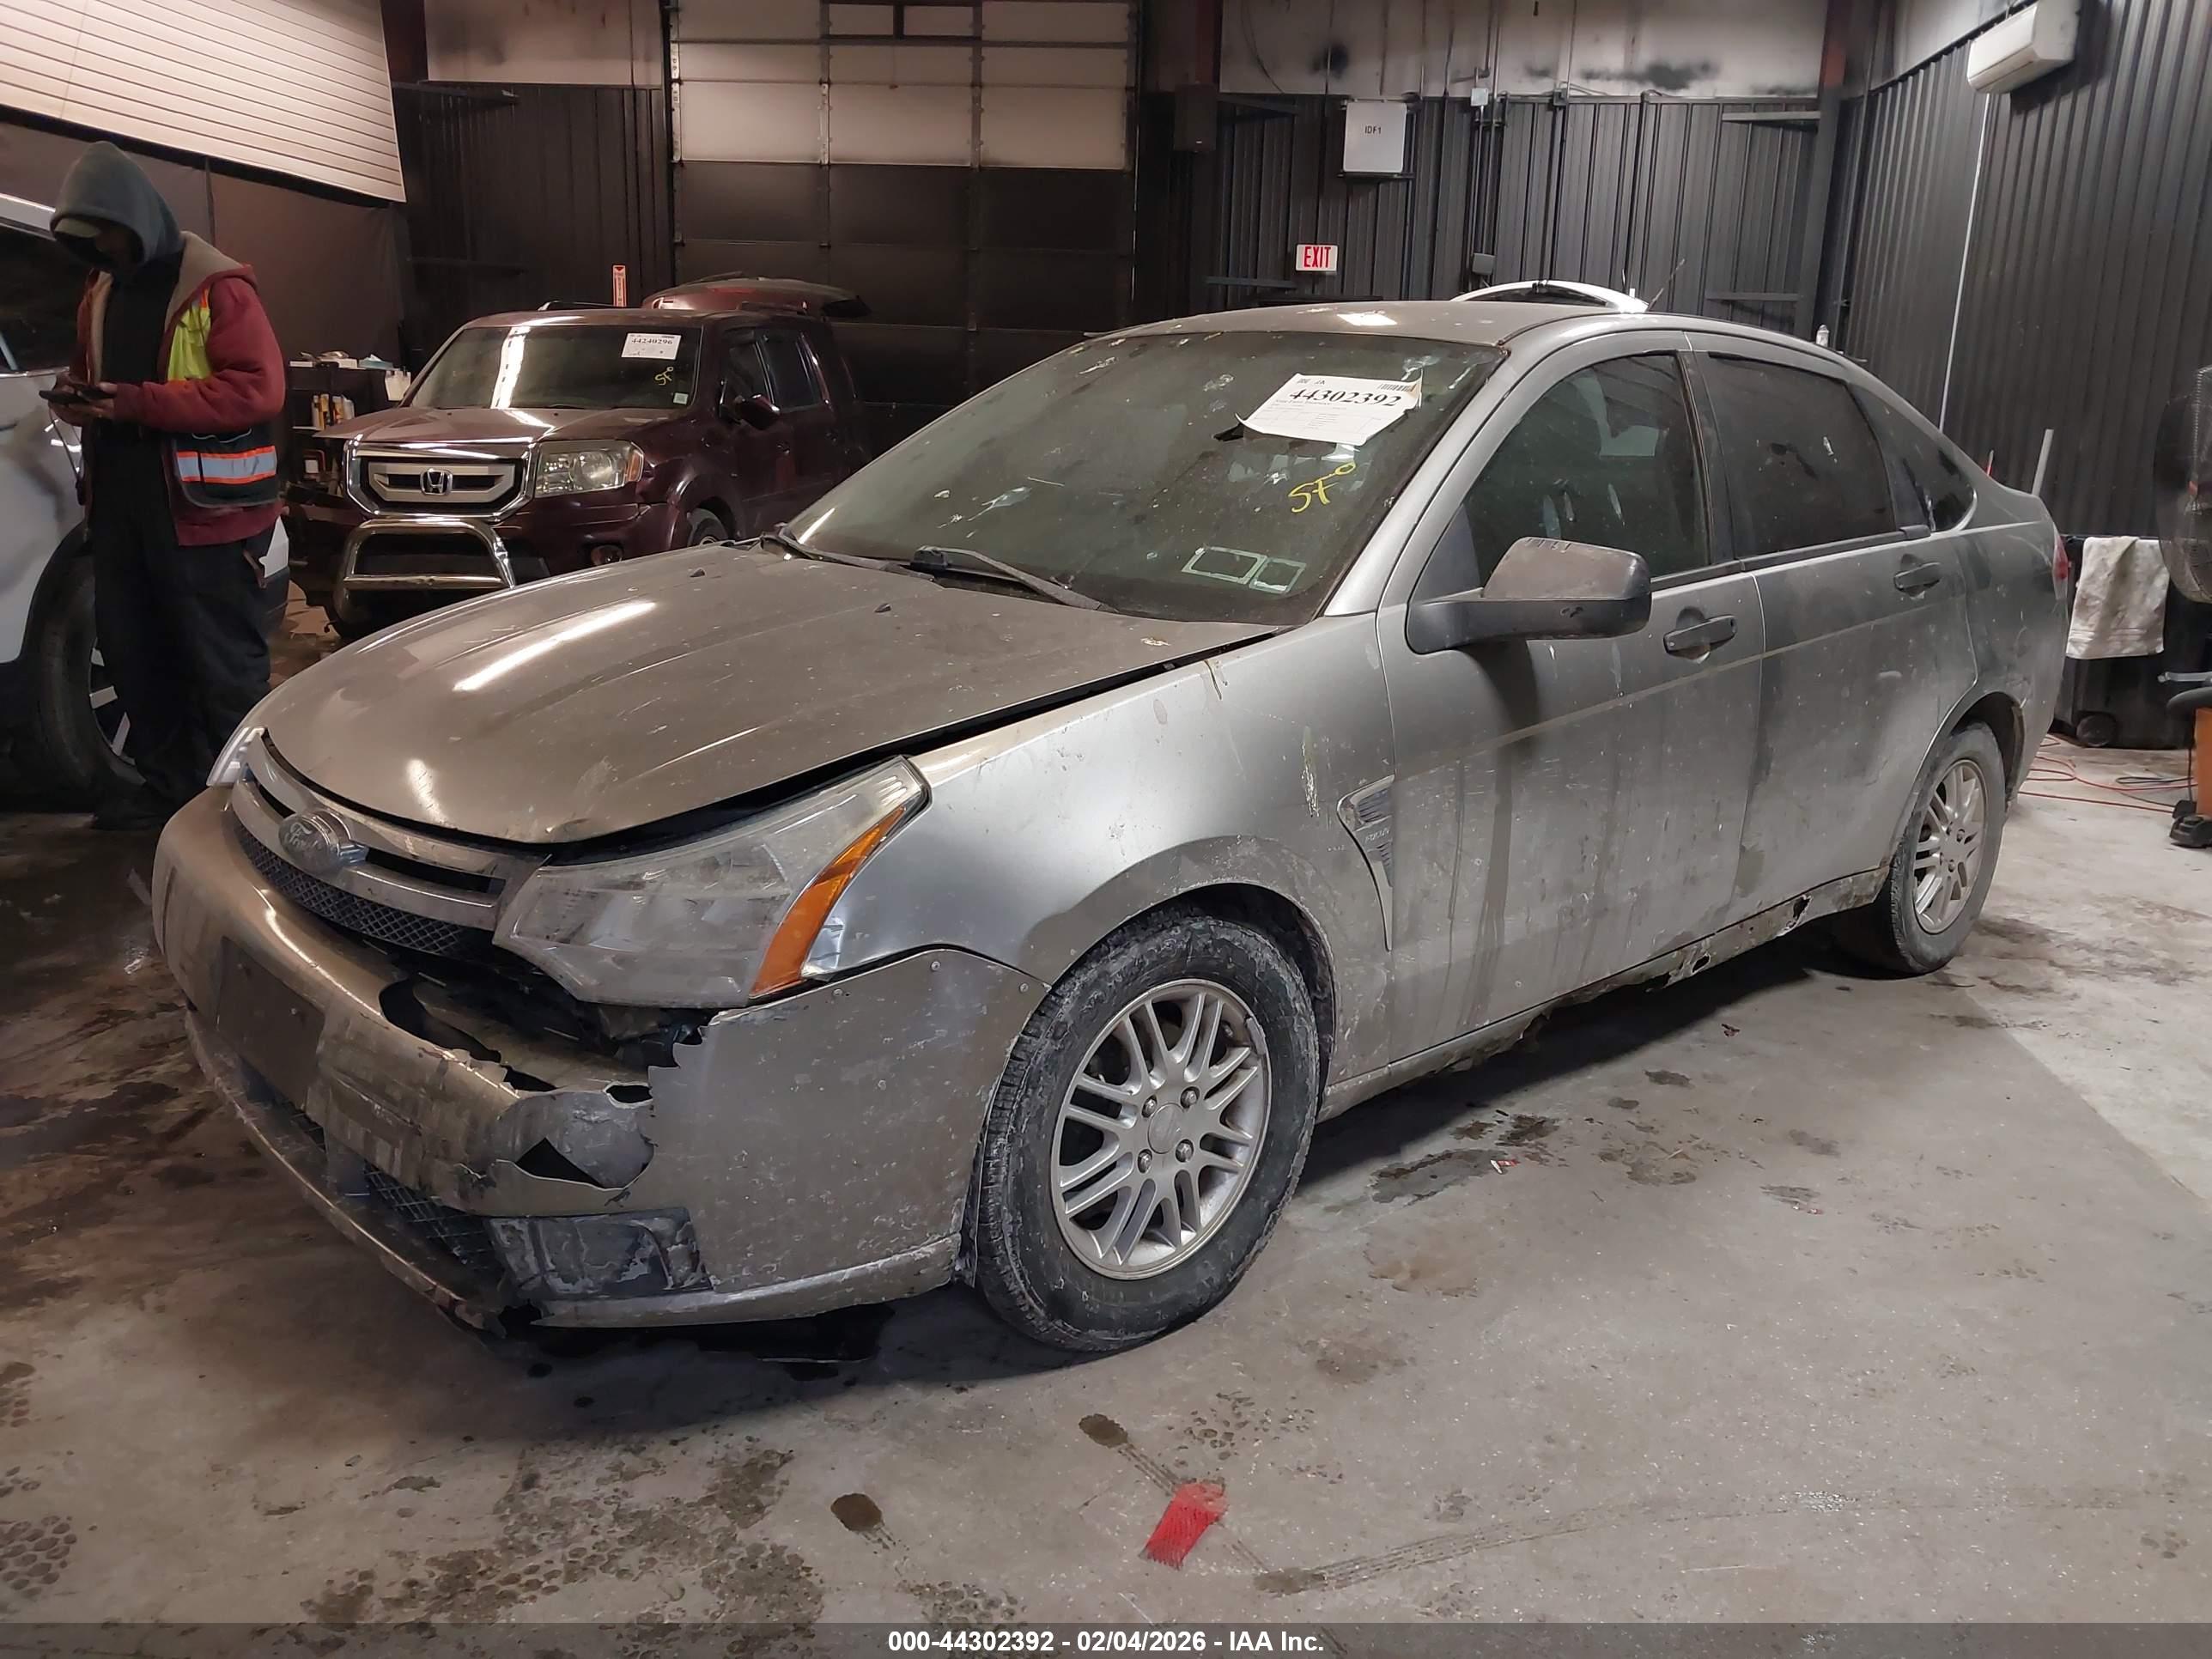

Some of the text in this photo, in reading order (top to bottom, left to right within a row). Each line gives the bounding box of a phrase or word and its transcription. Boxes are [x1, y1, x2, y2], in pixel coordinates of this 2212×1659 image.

[1364, 125, 1382, 134] IDF1
[1304, 246, 1332, 268] EXIT
[1290, 388, 1402, 407] 44302392
